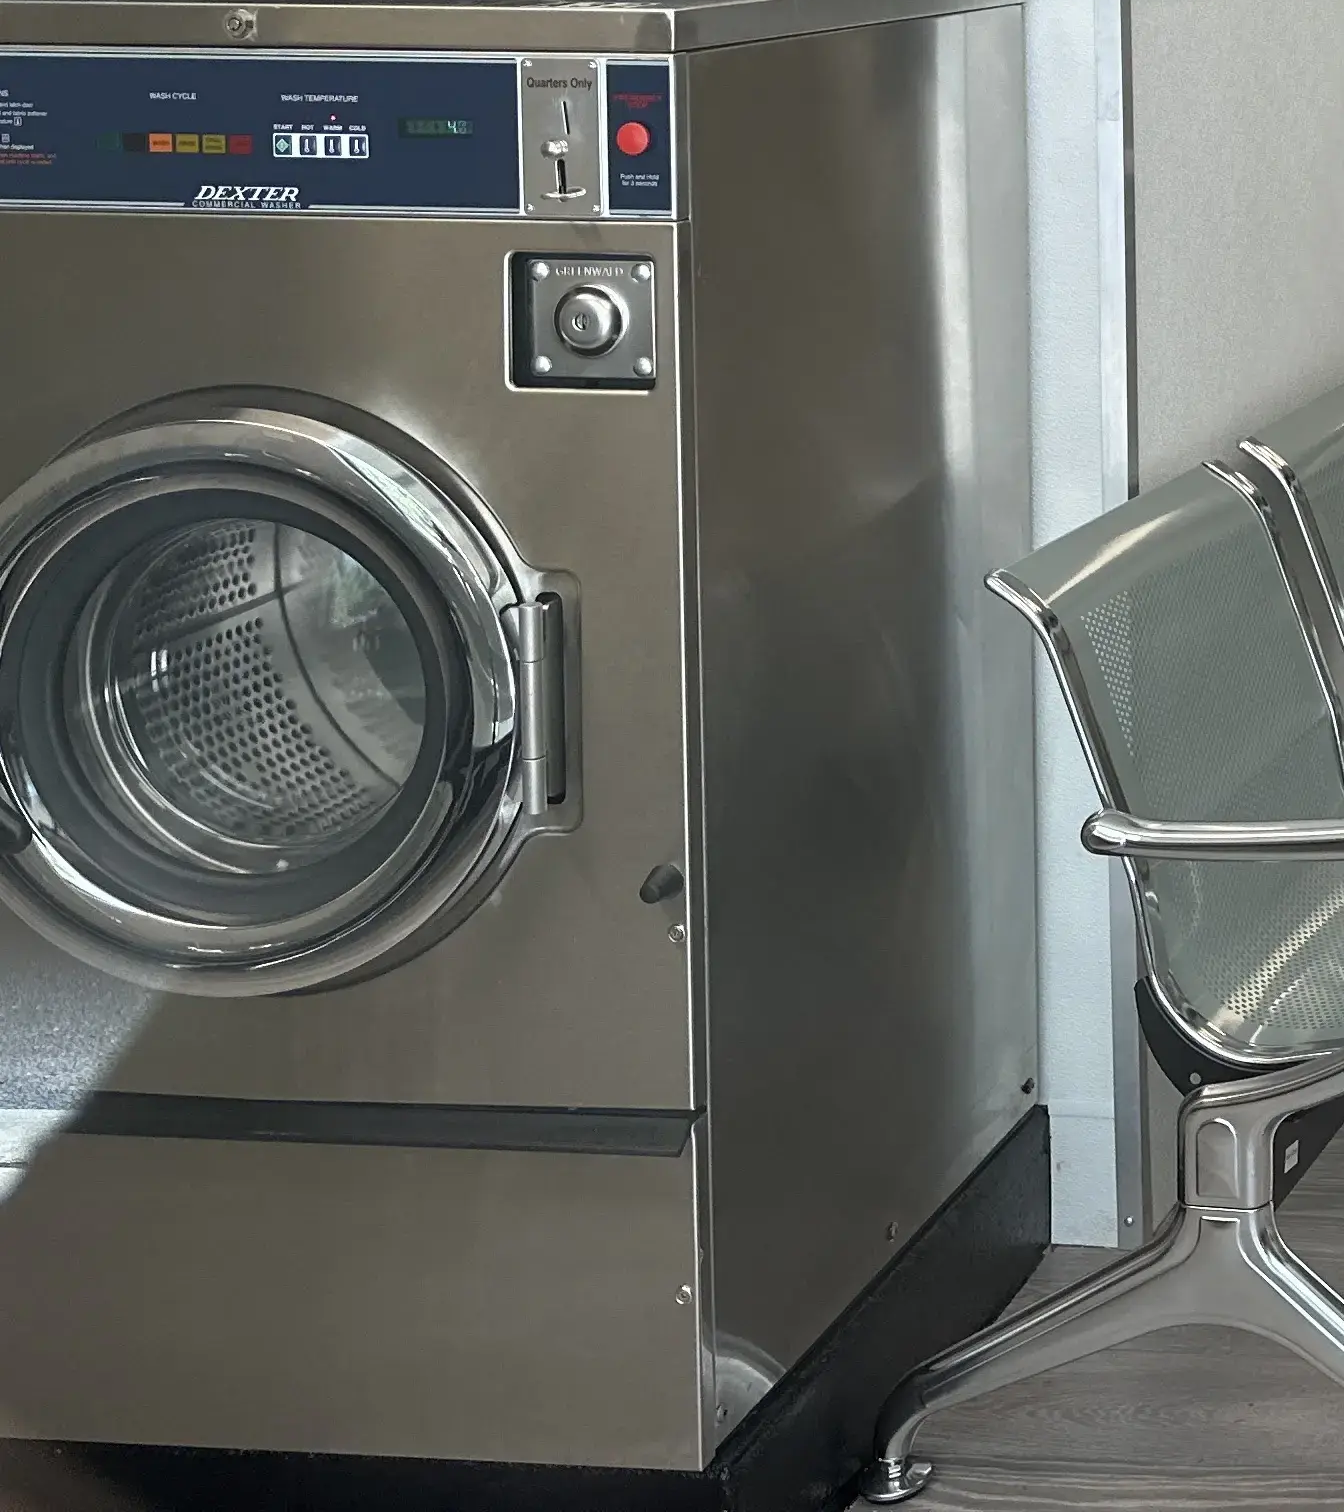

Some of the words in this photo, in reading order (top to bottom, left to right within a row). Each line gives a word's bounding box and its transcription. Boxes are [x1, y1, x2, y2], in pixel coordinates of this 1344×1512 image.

[526, 77, 568, 88] Quarters
[570, 77, 592, 91] Only
[172, 92, 197, 100] CYCLE
[304, 94, 359, 103] TEMPERATURE
[194, 185, 300, 201] DEXTER
[192, 200, 256, 208] COMMERCIAL
[260, 201, 301, 209] WASHER
[555, 266, 625, 277] GREENWALD
